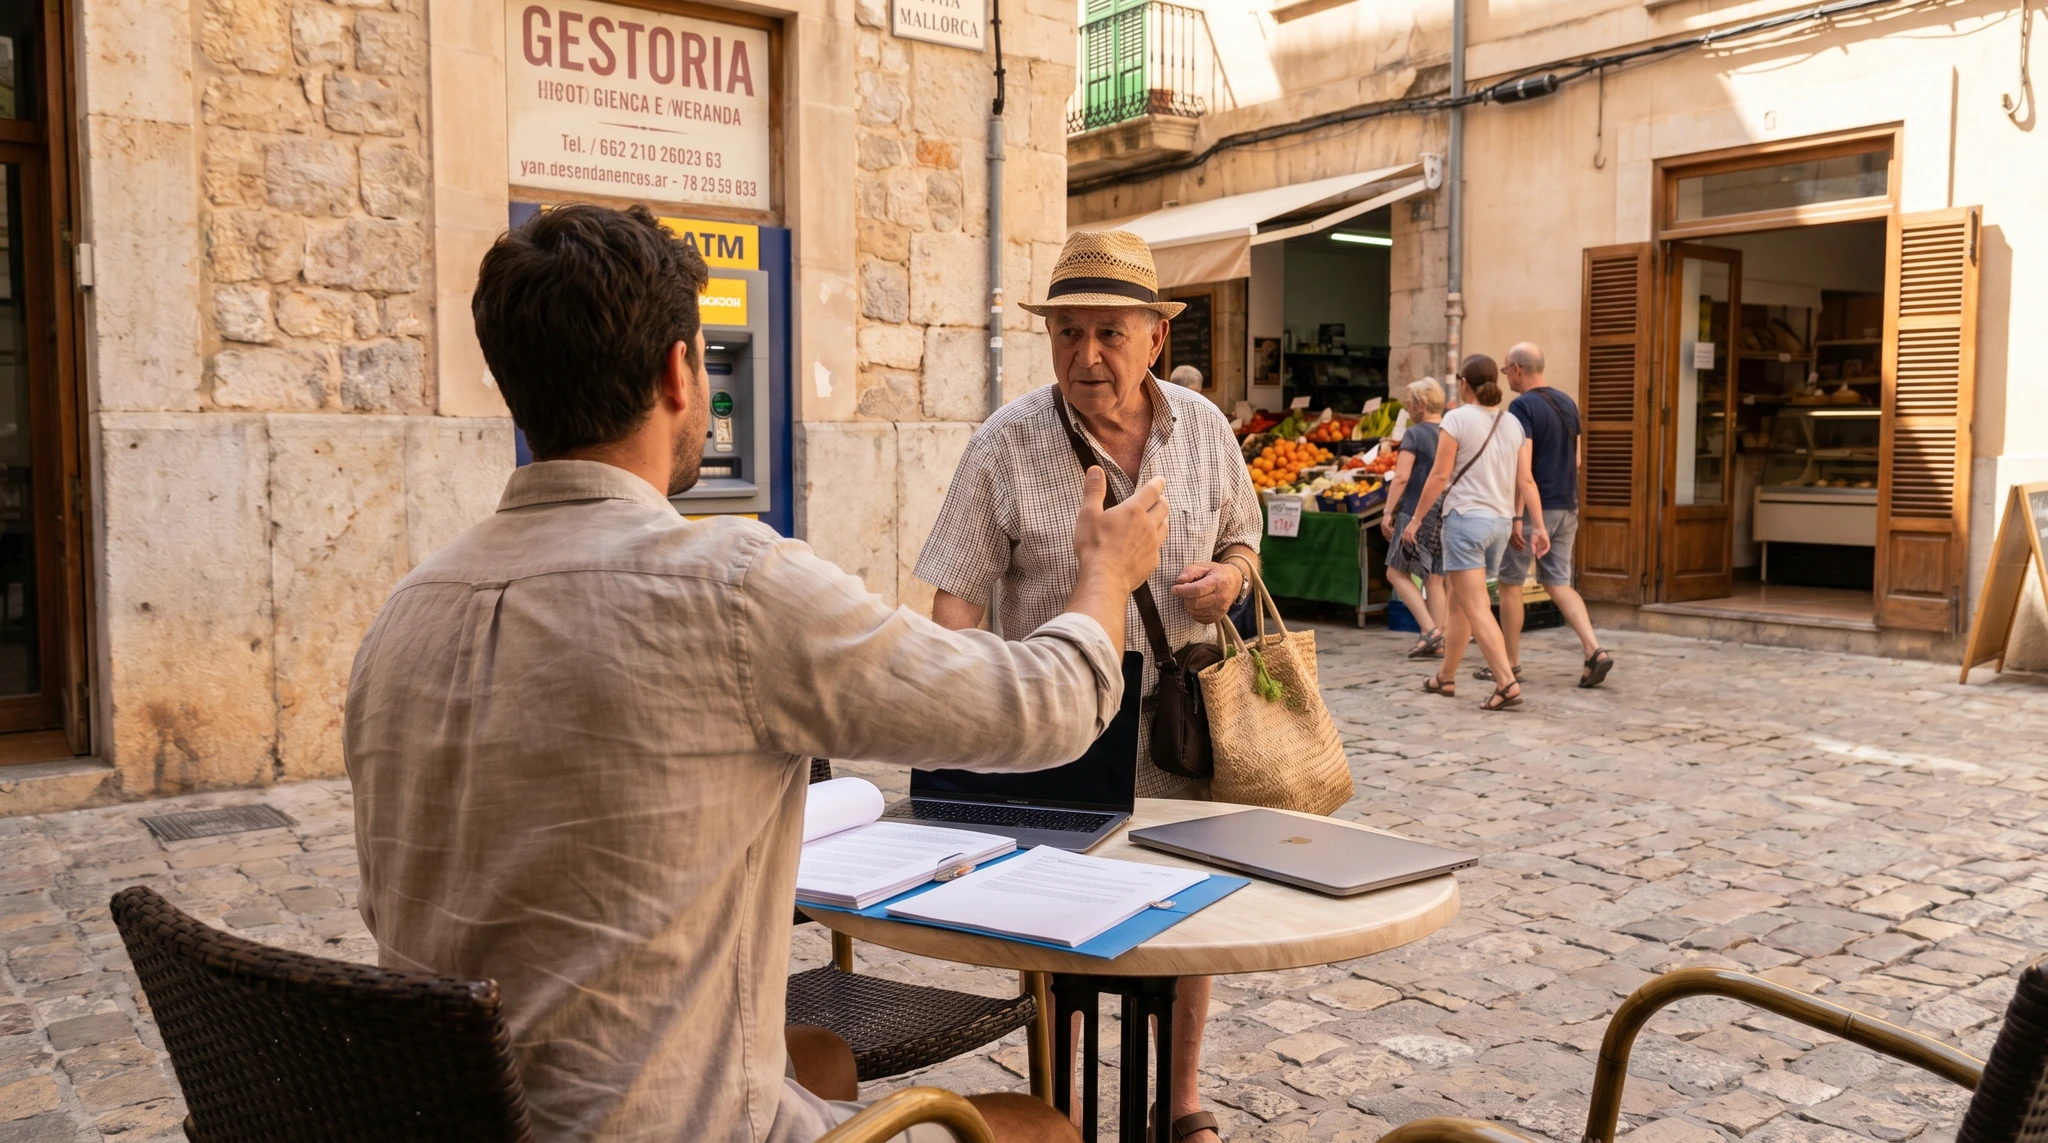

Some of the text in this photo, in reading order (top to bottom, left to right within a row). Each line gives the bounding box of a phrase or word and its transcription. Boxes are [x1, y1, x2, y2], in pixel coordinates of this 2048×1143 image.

[900, 7, 979, 39] MALLORCA
[522, 5, 754, 97] GESTORIA
[594, 87, 650, 115] GIENCA
[655, 96, 663, 115] E
[561, 134, 586, 154] Tel.
[600, 138, 626, 158] 662
[630, 142, 656, 161] 210
[660, 146, 702, 167] 26023
[705, 152, 722, 169] 63
[682, 174, 698, 191] 78
[701, 176, 715, 193] 29
[718, 178, 732, 194] 59
[735, 180, 757, 197] 833
[682, 231, 744, 260] ATM
